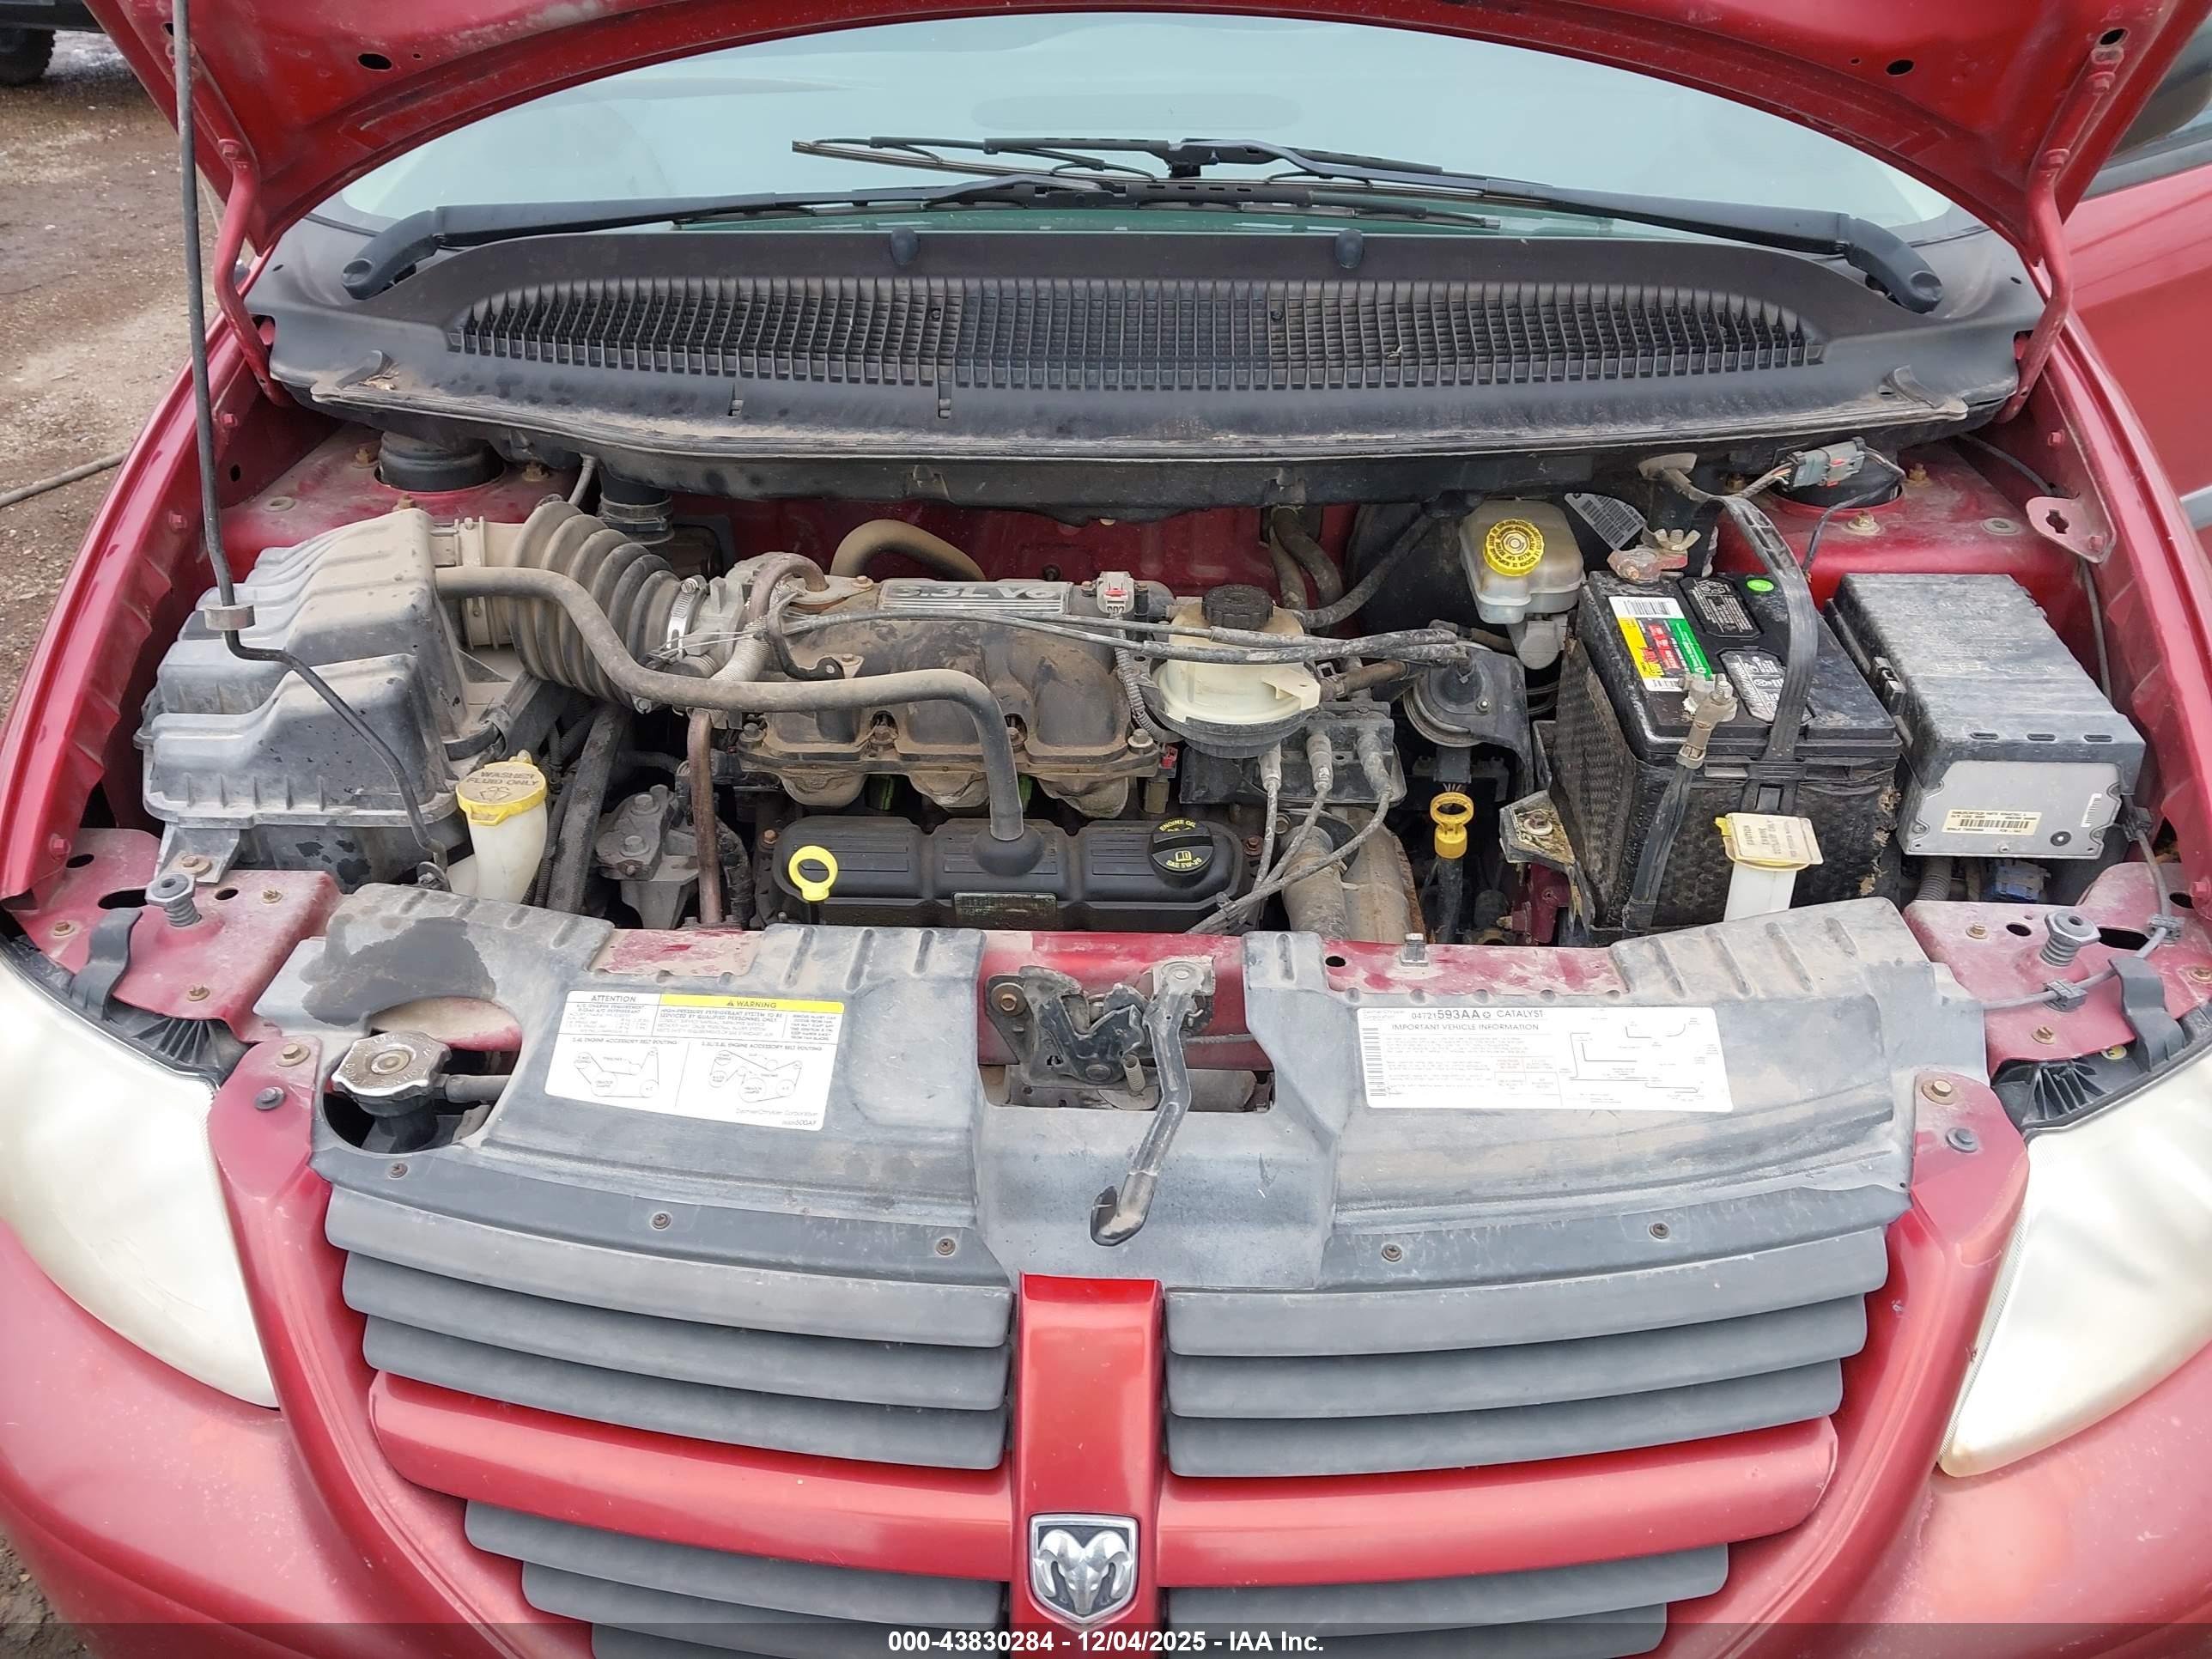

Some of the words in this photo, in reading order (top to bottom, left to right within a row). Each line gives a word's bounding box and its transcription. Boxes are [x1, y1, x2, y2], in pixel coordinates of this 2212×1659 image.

[997, 586, 1054, 599] V6
[480, 771, 535, 780] WASHER
[1159, 819, 1184, 831] ENGINE
[1165, 860, 1180, 868] SAE
[736, 1000, 777, 1008] WARNING
[1496, 1009, 1544, 1018] CATALYST
